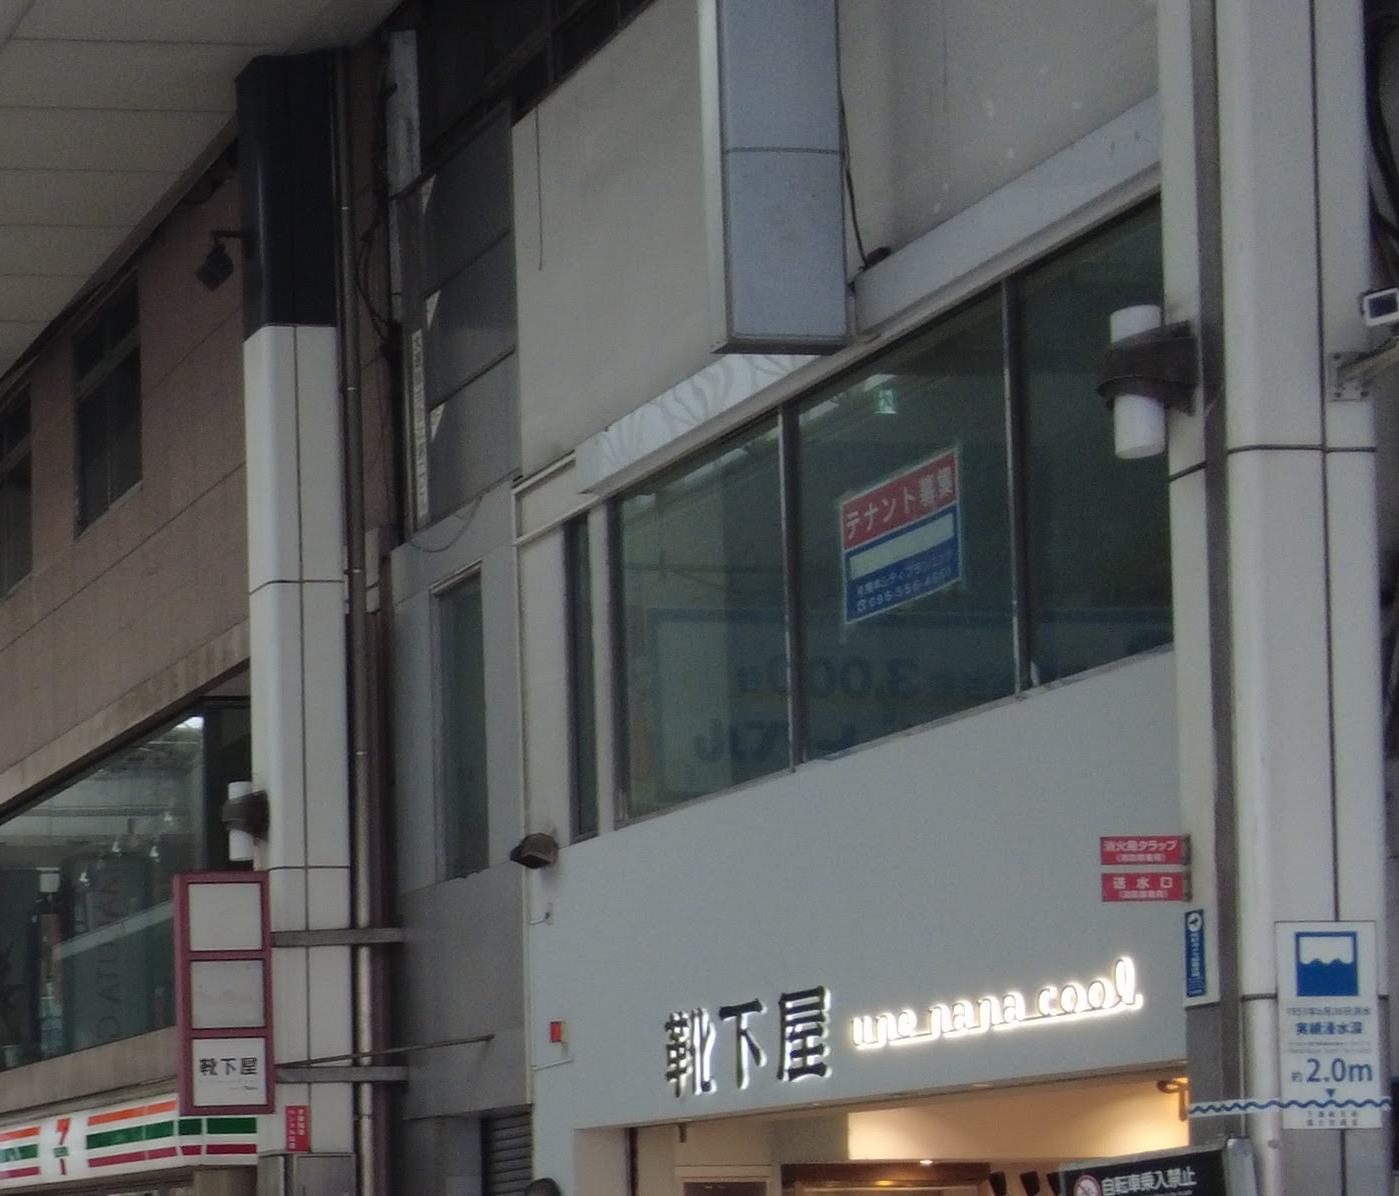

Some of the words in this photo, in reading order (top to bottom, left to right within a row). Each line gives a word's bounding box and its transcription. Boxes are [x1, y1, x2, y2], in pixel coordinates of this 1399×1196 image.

[850, 1006, 916, 1048] une
[928, 992, 1026, 1040] nana
[1037, 955, 1144, 1017] cool
[198, 1057, 259, 1077] 靴下屋
[664, 984, 833, 1099] 靴下屋
[1306, 1057, 1373, 1083] 2.0m
